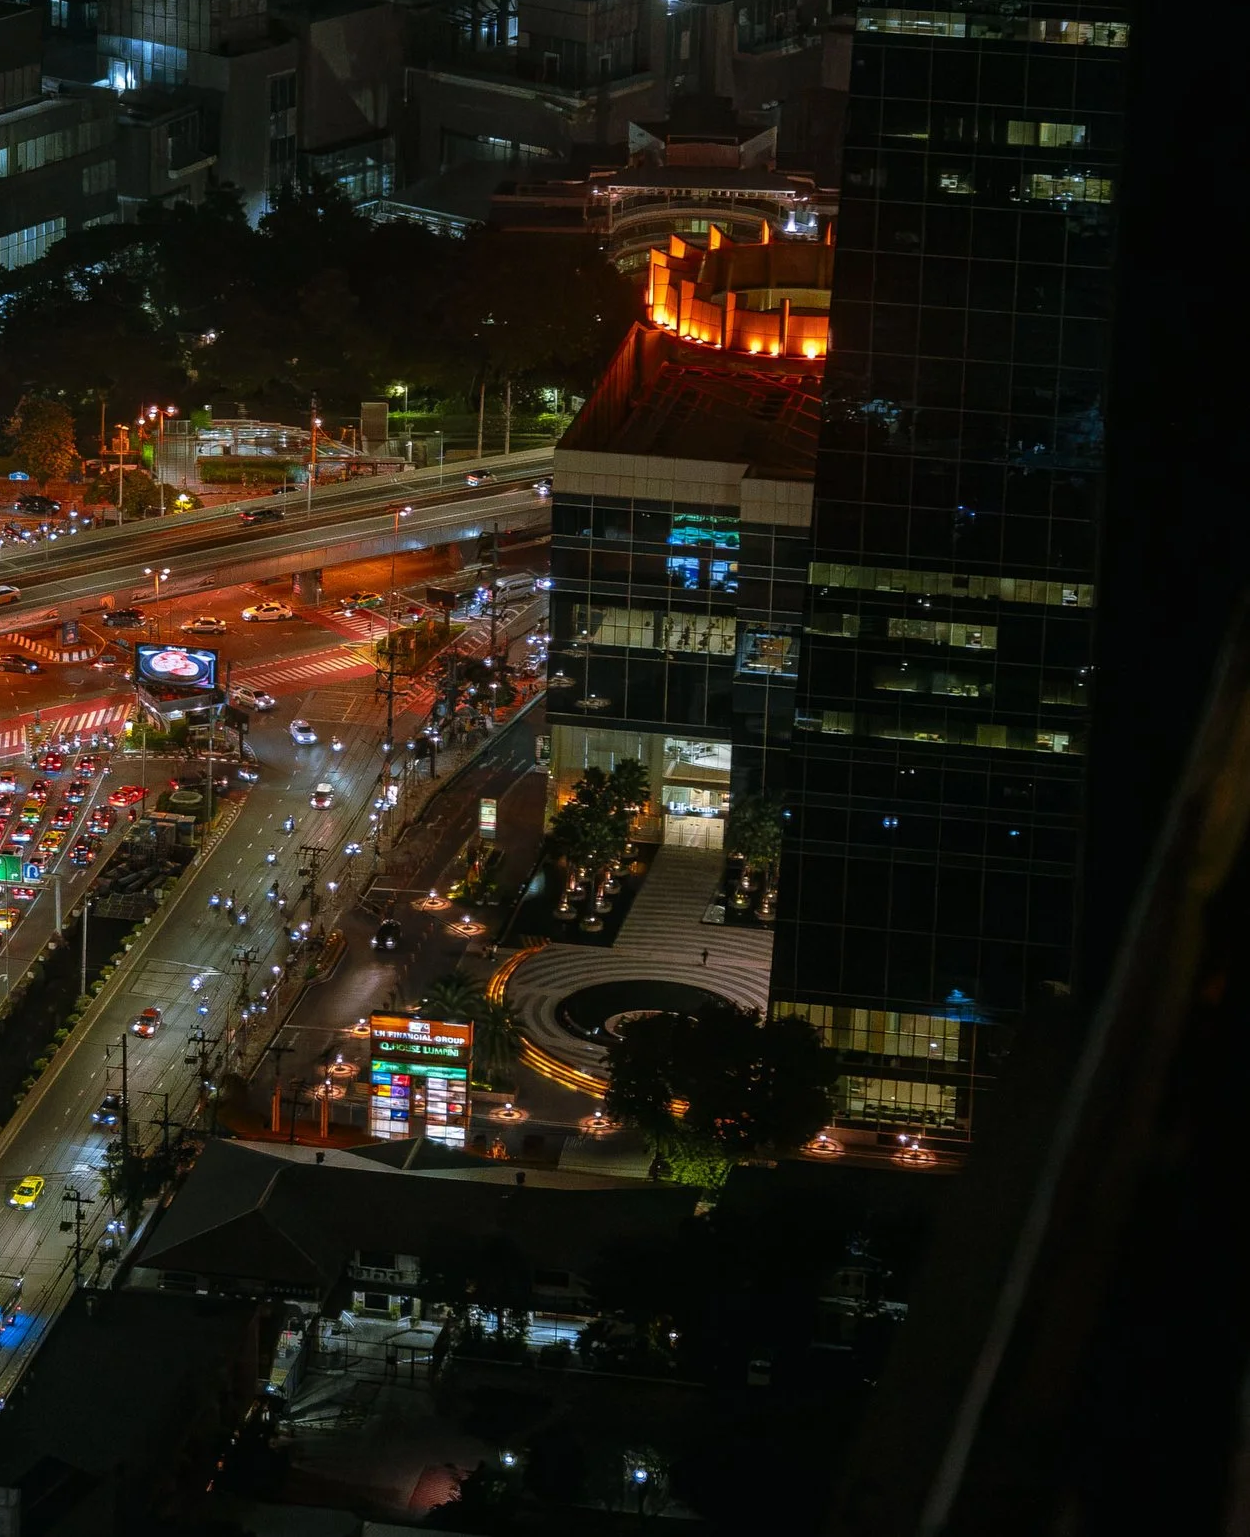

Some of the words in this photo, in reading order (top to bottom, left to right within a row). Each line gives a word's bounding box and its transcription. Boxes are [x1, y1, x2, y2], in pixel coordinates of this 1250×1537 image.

[387, 1031, 432, 1042] FINANCIAL
[434, 1035, 465, 1045] GROUP
[422, 1045, 459, 1057] LUMPINI
